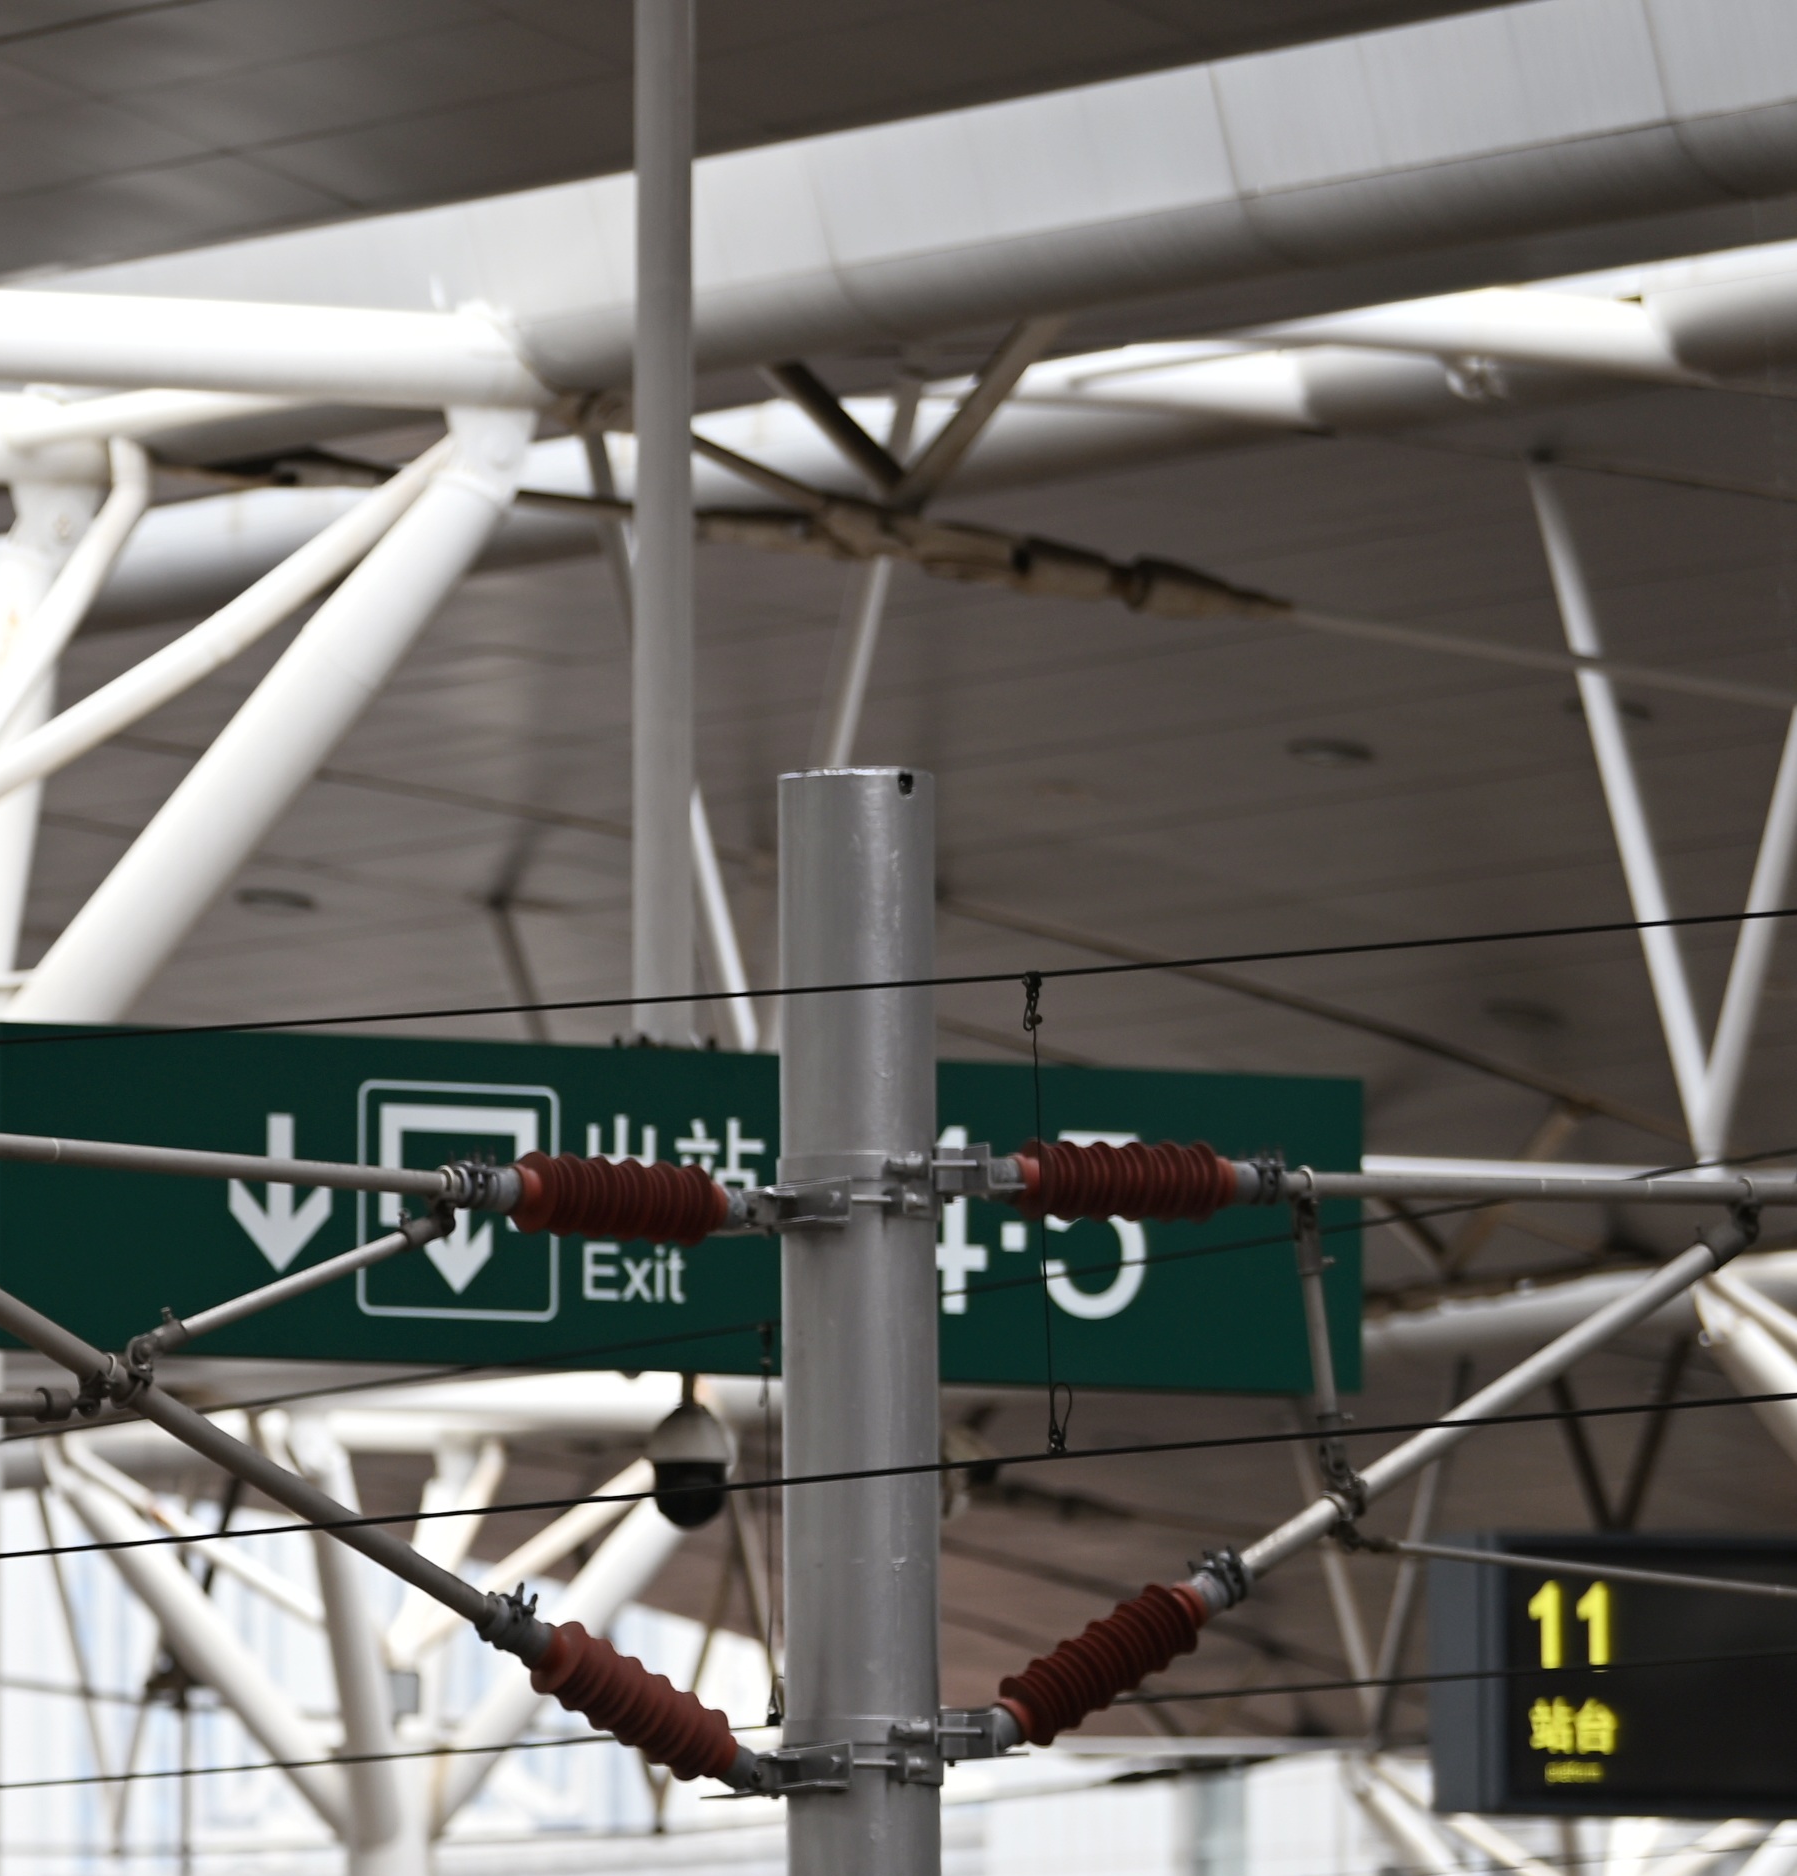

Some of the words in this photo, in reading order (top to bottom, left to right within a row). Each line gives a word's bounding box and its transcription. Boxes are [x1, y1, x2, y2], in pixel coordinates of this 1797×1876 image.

[582, 1243, 687, 1304] Exit
[1528, 1580, 1610, 1672] 11
[1528, 1696, 1618, 1755] 站台
